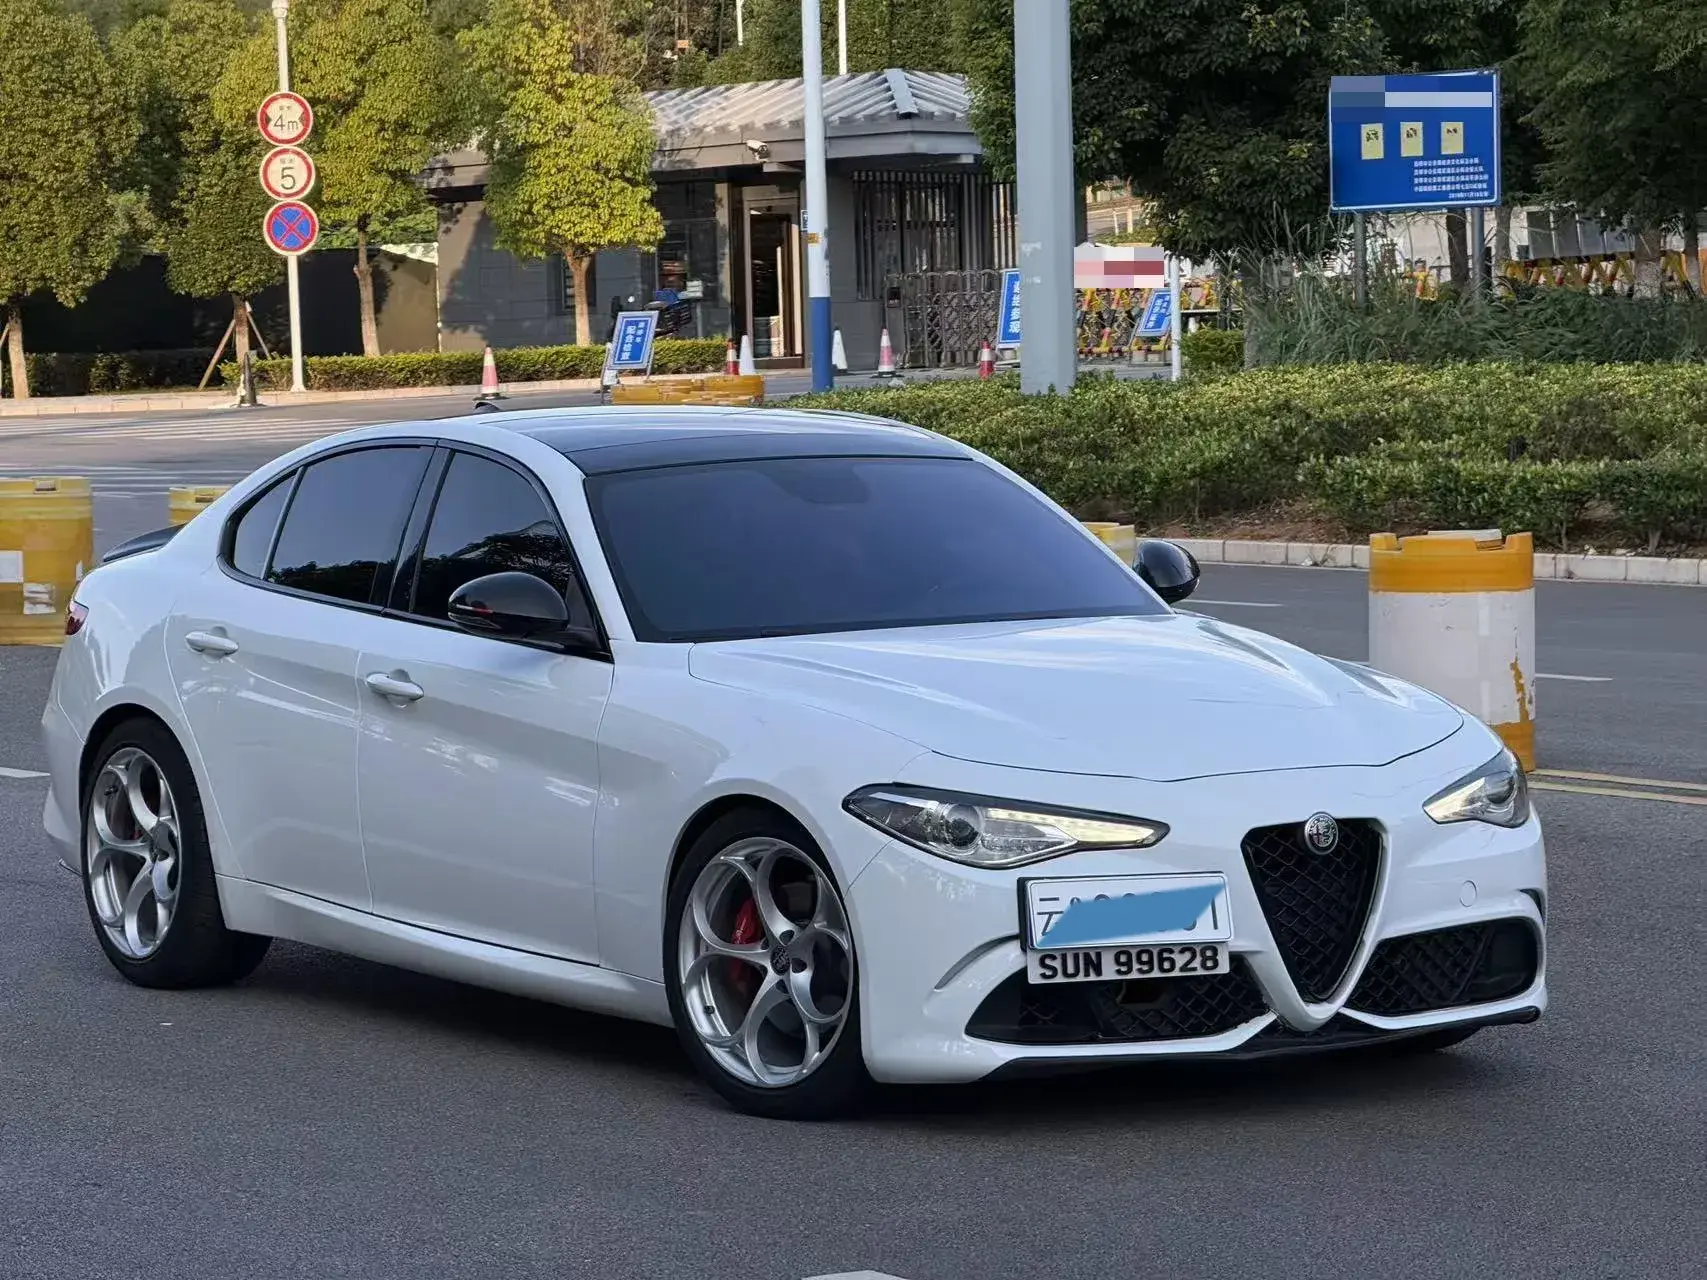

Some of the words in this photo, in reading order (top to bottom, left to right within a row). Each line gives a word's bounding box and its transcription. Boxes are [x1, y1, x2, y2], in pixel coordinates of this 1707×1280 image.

[274, 114, 299, 131] 4m
[281, 166, 296, 190] 5
[620, 325, 637, 361] 配合检查
[1038, 951, 1104, 980] SUN
[1113, 944, 1220, 976] 99628
